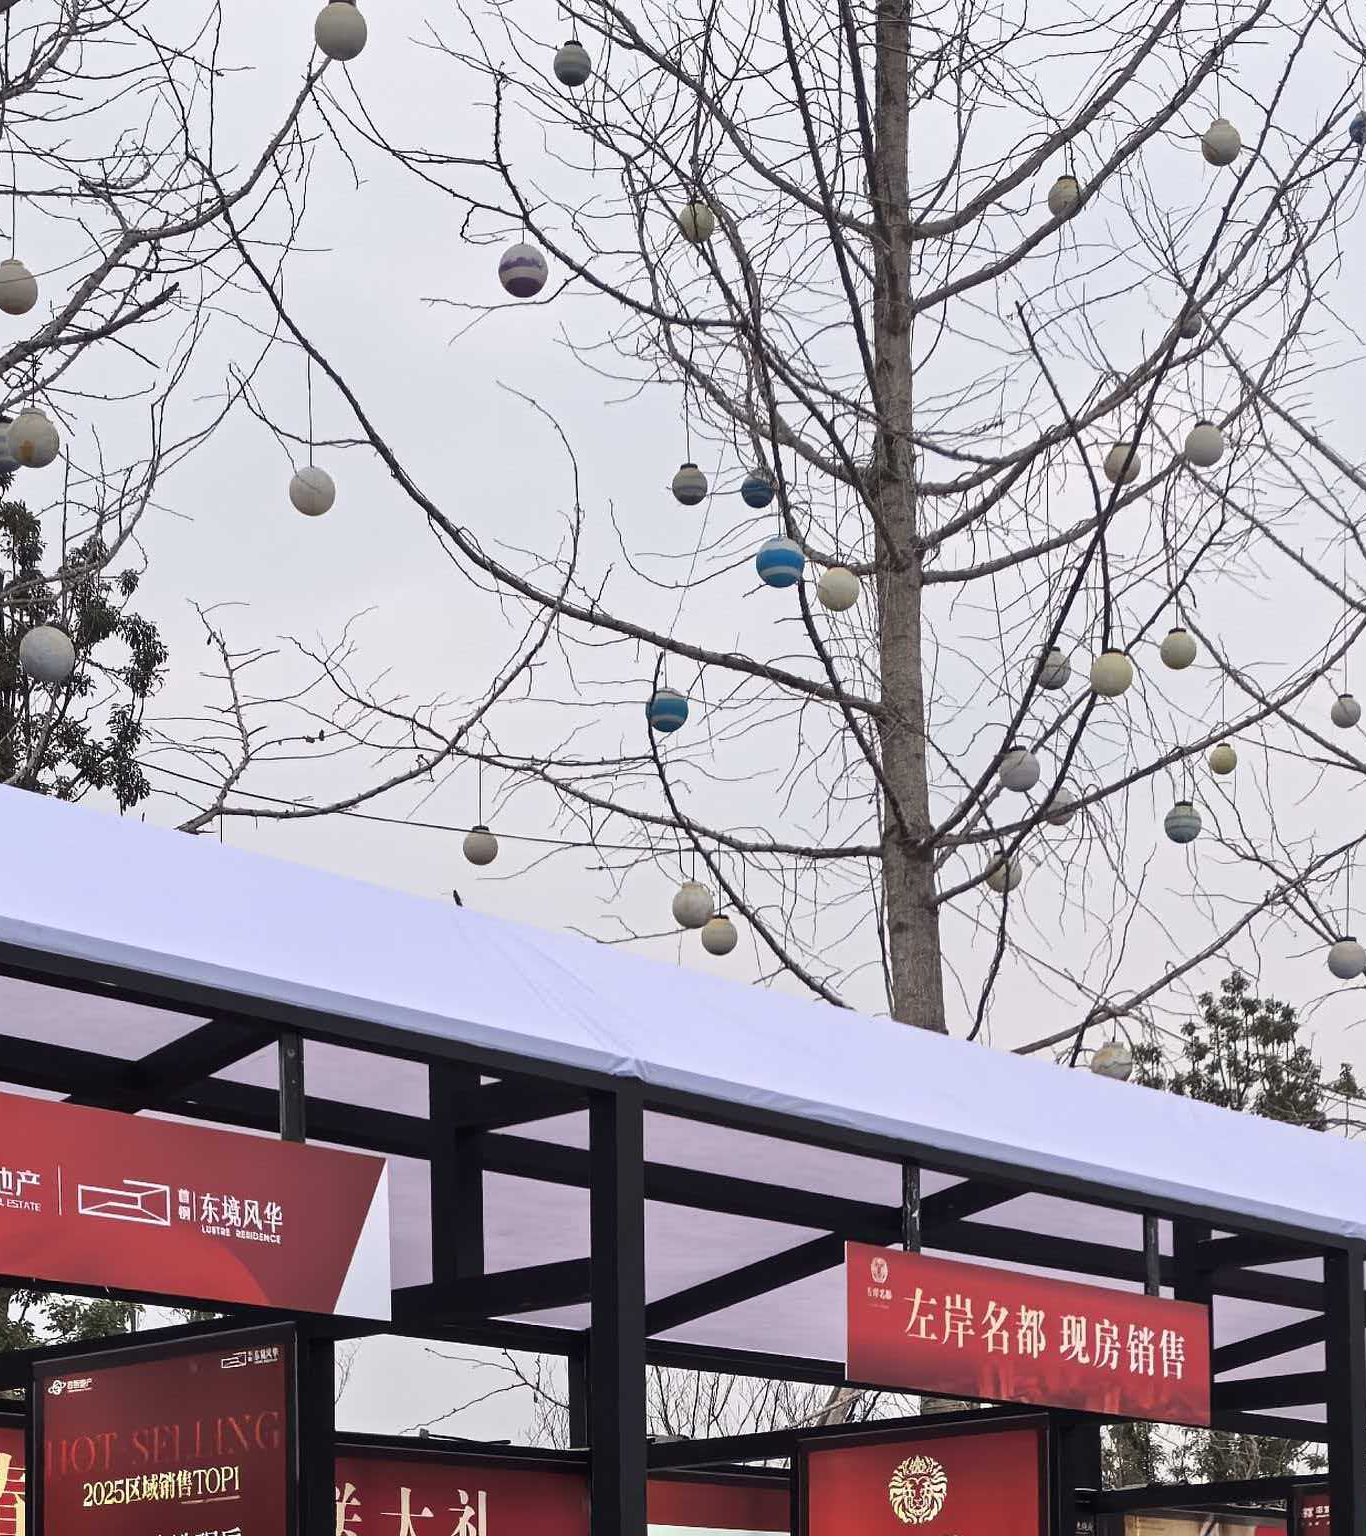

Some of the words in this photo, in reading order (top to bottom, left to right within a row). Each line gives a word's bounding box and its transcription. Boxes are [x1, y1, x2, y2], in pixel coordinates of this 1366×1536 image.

[6, 1199, 41, 1212] ESTATE
[200, 1193, 283, 1233] 东境风华
[904, 1287, 1047, 1359] 左岸名都
[1059, 1314, 1186, 1380] 现房销售
[43, 1432, 118, 1478] HOT
[131, 1410, 281, 1465] SELLING
[82, 1465, 240, 1507] 2025区域销售TOP1
